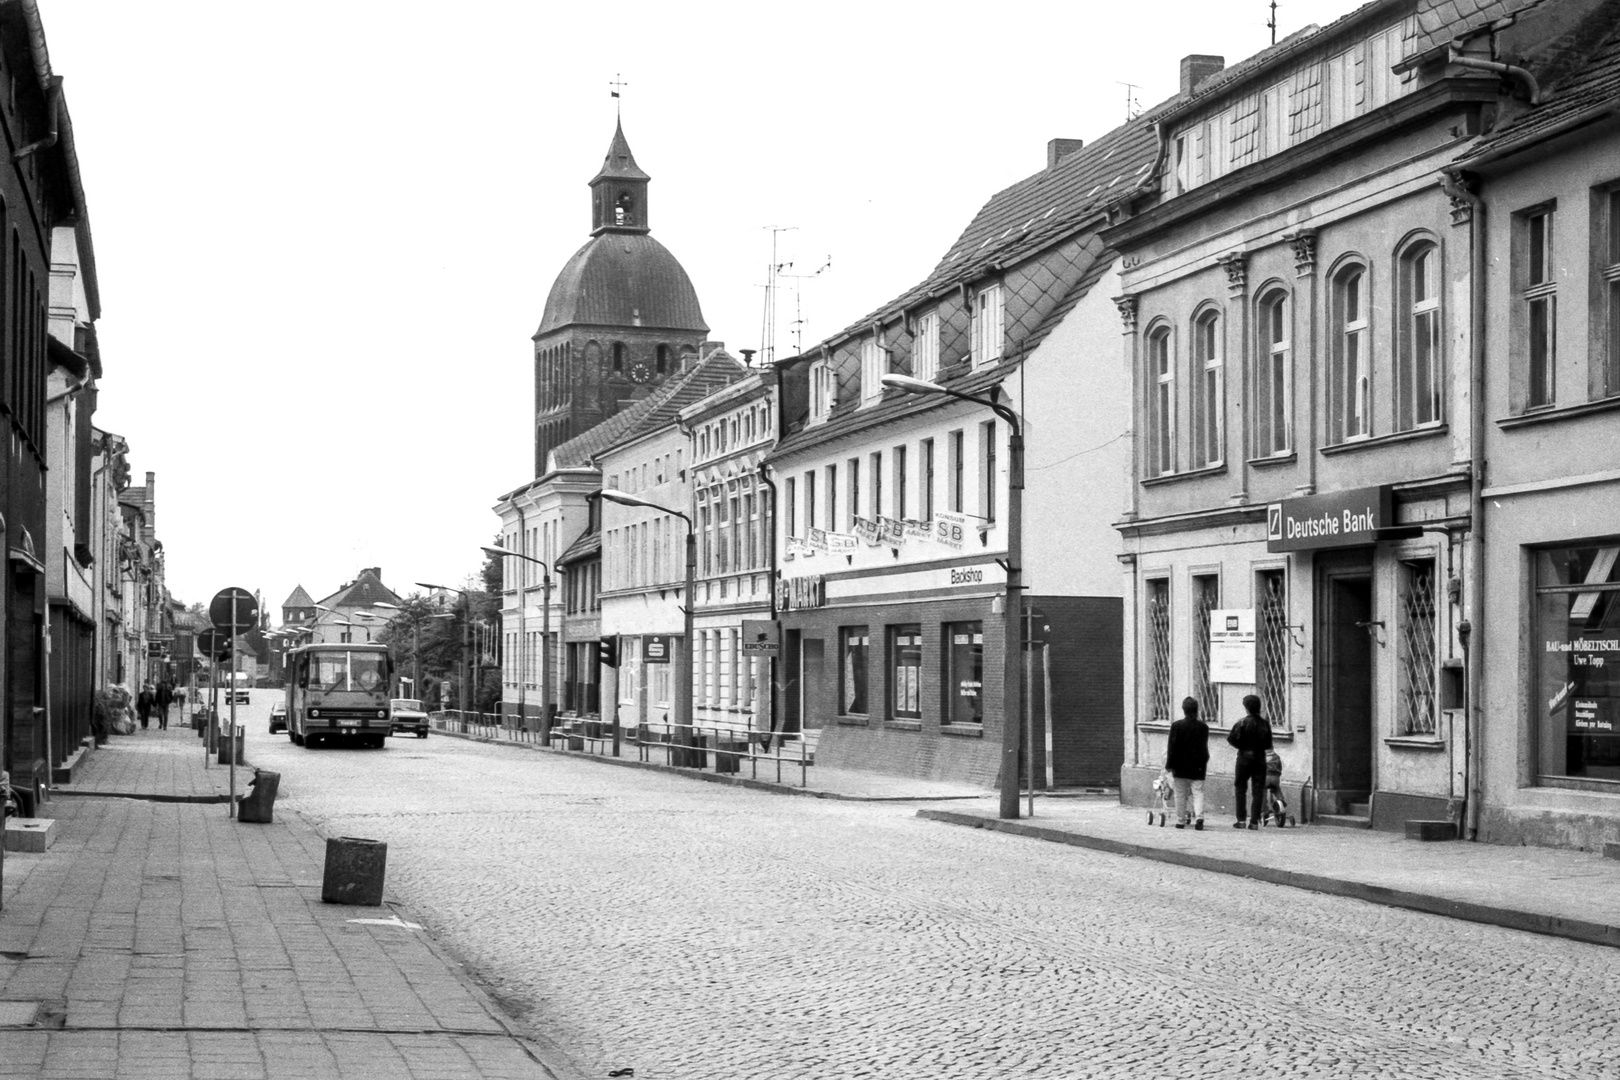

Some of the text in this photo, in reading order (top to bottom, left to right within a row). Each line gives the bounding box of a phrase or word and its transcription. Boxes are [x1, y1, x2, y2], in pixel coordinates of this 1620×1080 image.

[935, 512, 965, 523] KONSUM
[1287, 506, 1375, 539] Deutsche Bank
[939, 521, 962, 541] SB
[936, 536, 962, 551] MARKT
[951, 566, 983, 586] Backshop
[744, 642, 779, 651] EDUSCHO
[1573, 654, 1587, 666] Uwe
